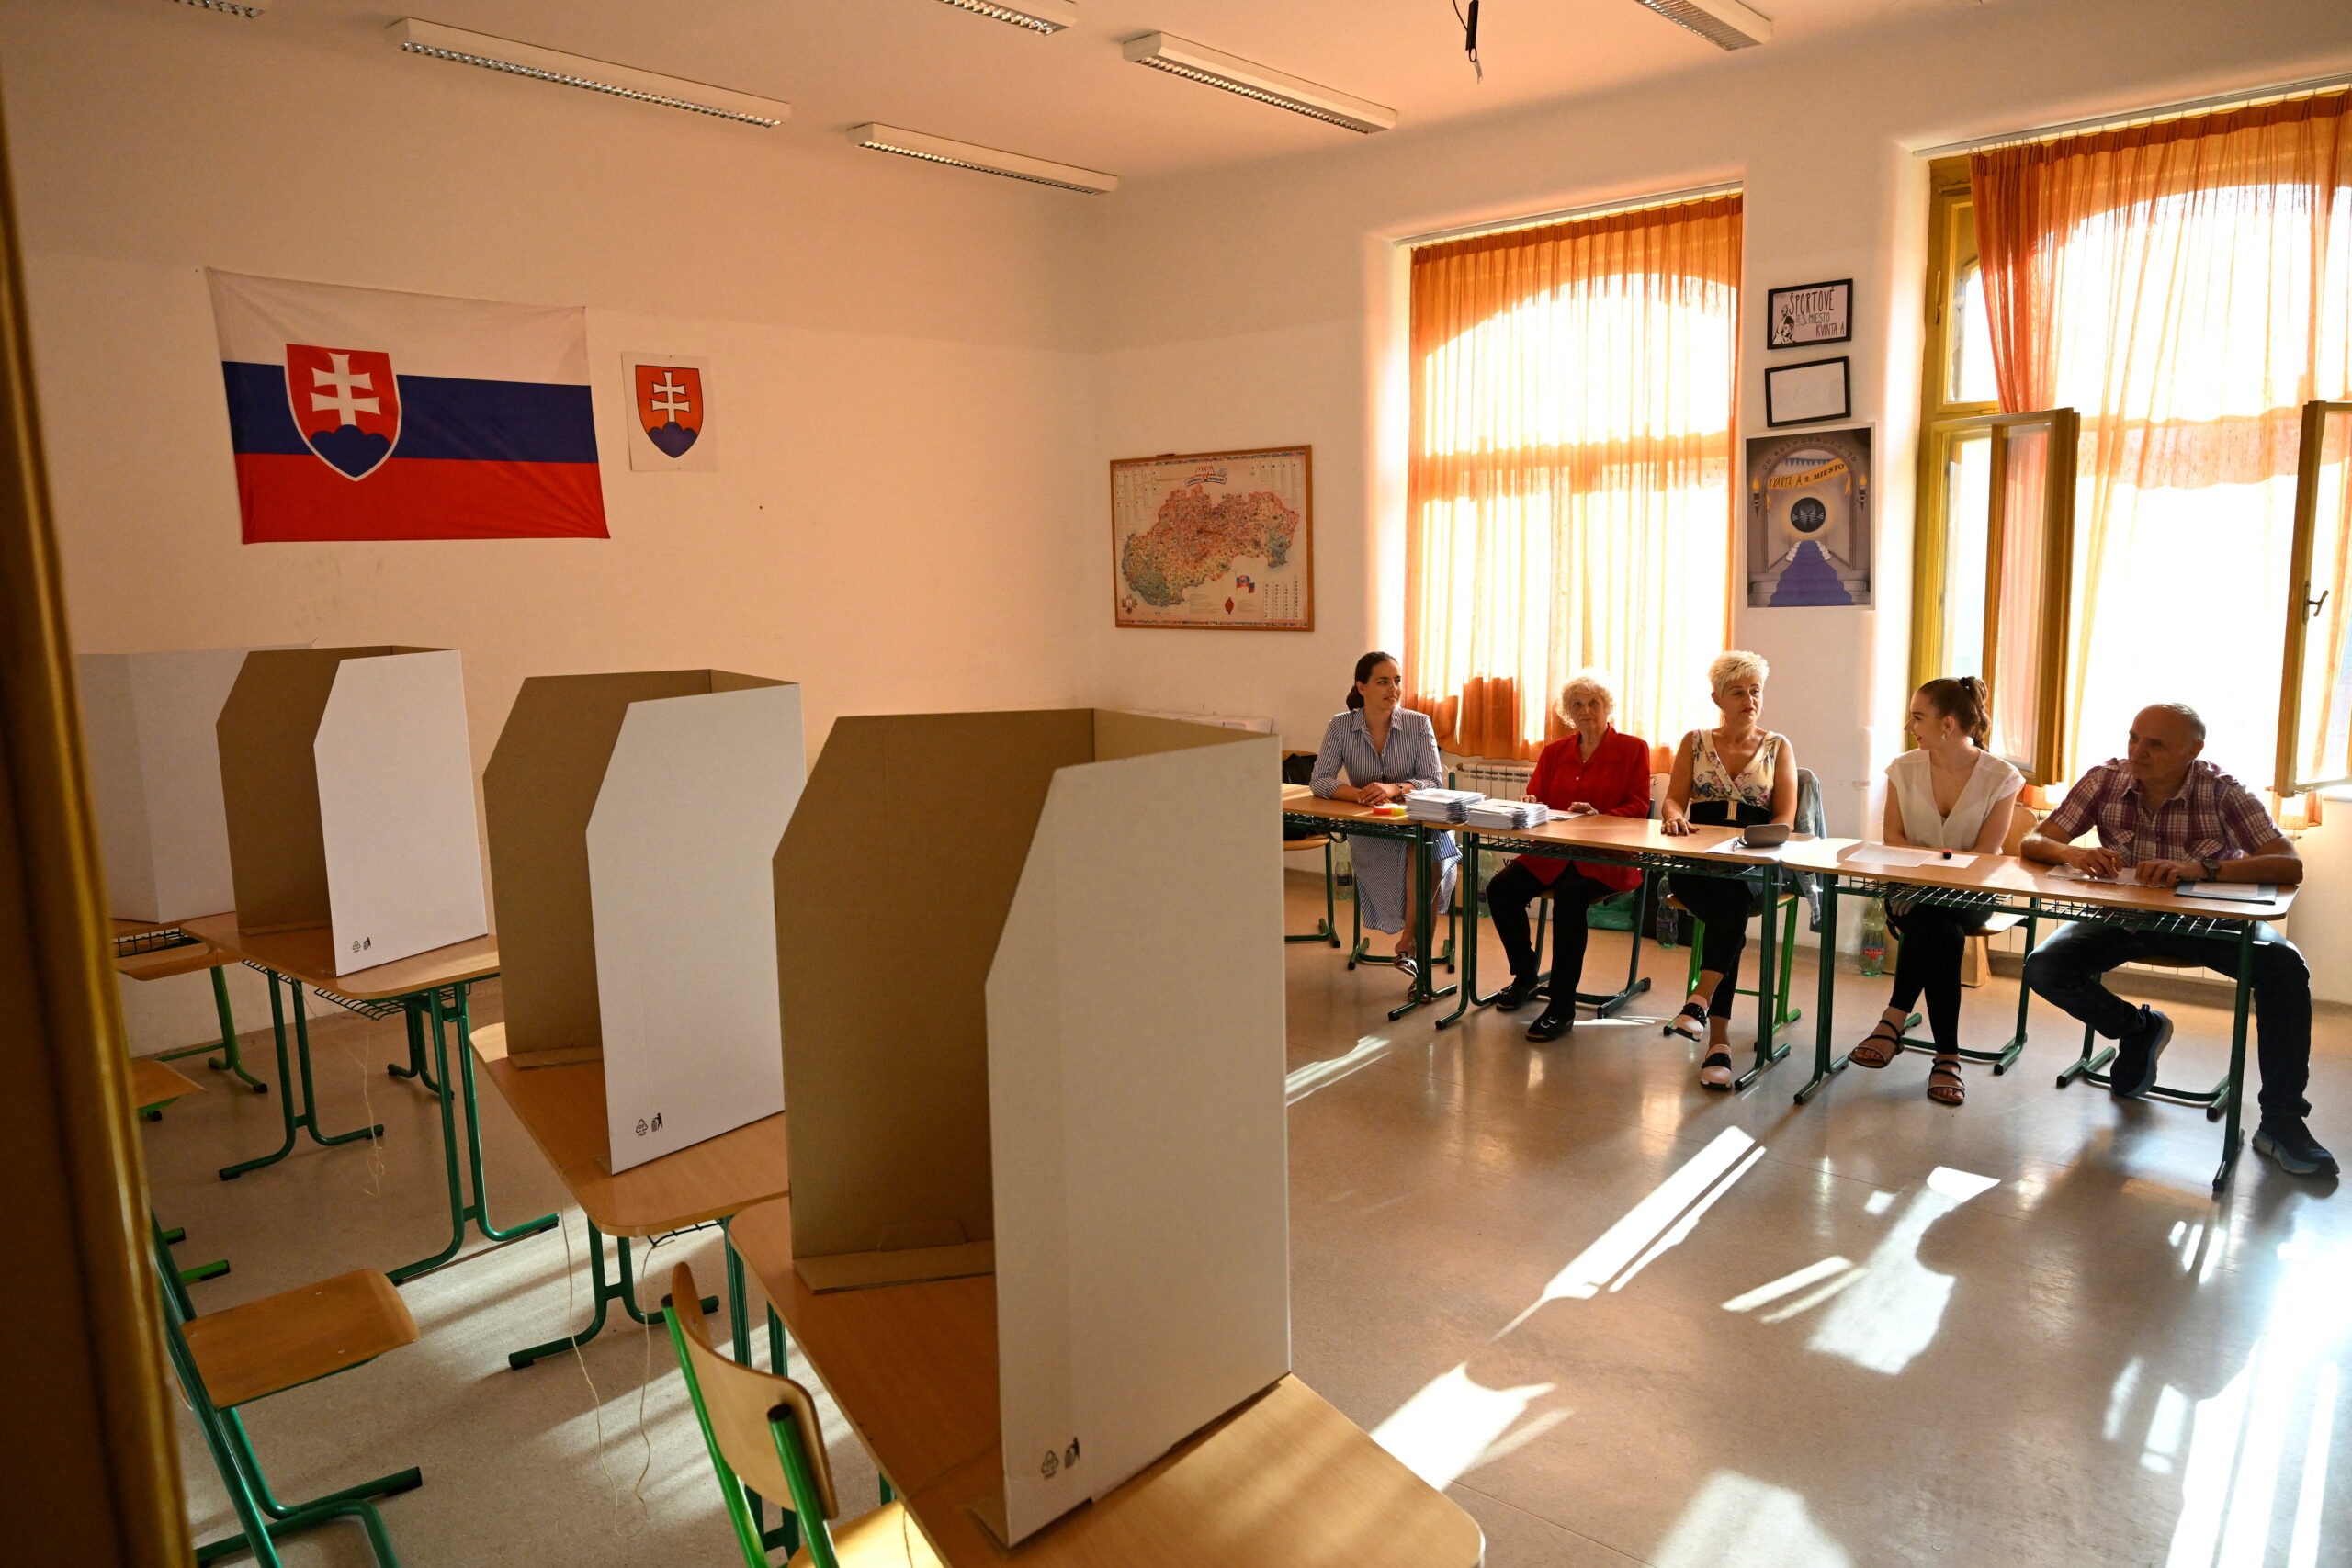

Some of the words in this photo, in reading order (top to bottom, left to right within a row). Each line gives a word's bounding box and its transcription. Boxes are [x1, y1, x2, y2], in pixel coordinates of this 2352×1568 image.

[1808, 312, 1831, 324] MIESTO
[1816, 323, 1838, 337] KVINTA
[1839, 321, 1845, 335] A
[1813, 463, 1845, 480] MIESTO
